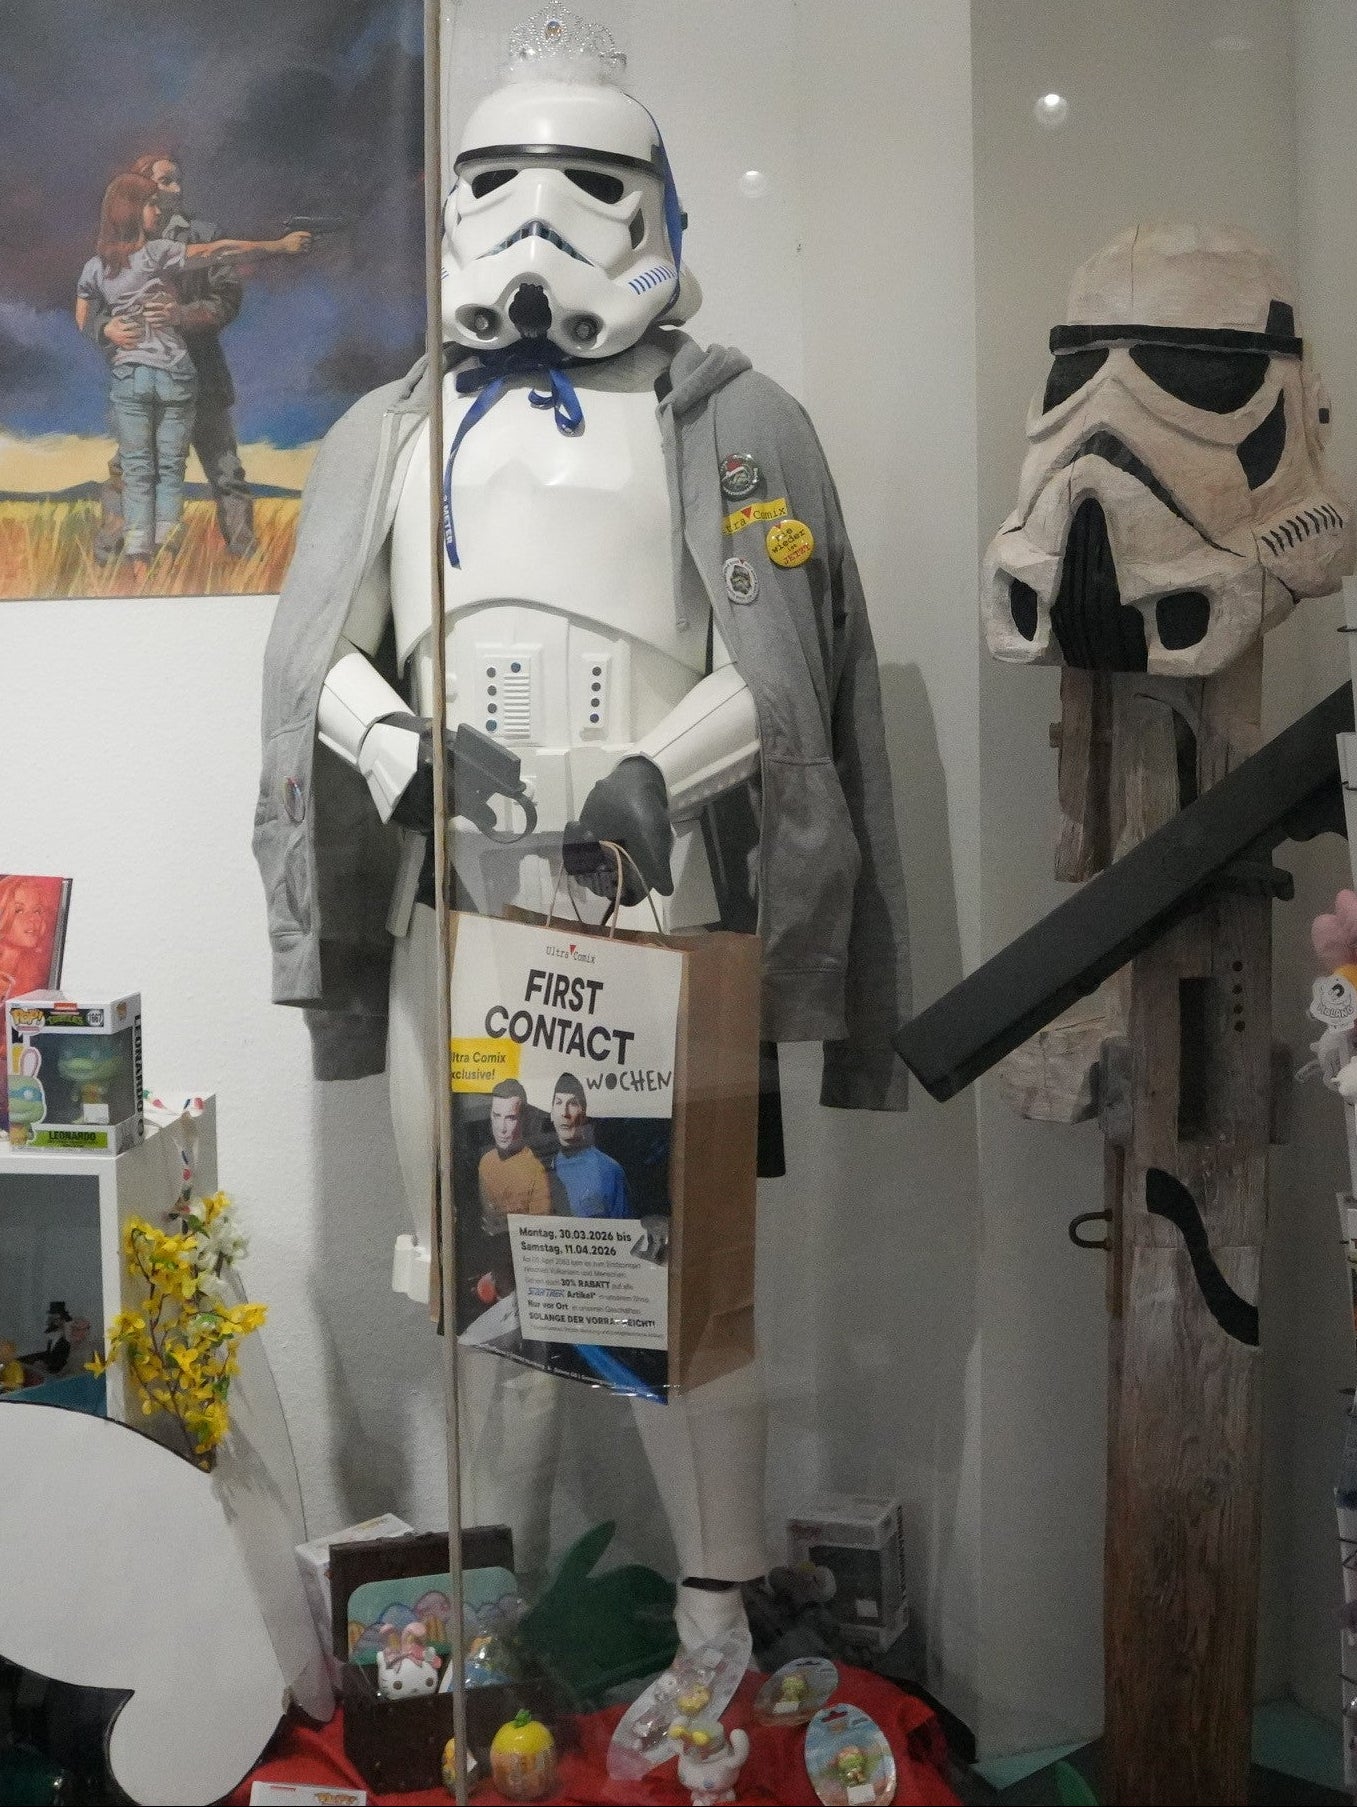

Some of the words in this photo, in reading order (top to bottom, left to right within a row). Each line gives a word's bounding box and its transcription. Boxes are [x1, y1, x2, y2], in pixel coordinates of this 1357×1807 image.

[725, 518, 747, 533] tra
[753, 507, 787, 520] Comix
[546, 946, 569, 959] Ultra
[573, 951, 597, 963] Comix
[524, 968, 604, 1015] FIRST
[484, 1004, 635, 1065] CONTACT
[452, 1052, 470, 1063] ltra
[472, 1051, 506, 1063] Comix
[451, 1068, 495, 1080] xclusive!
[586, 1070, 672, 1092] WOCHEN
[48, 1131, 97, 1141] LEONARDO
[519, 1227, 557, 1239] Montag,
[559, 1229, 614, 1241] 30.03.2026
[616, 1232, 632, 1242] bis
[521, 1241, 563, 1254] Samstag,
[564, 1244, 617, 1256] 11.04.2026
[560, 1278, 577, 1287] 30%
[578, 1280, 610, 1289] RABATT
[556, 1302, 569, 1310] Ort
[529, 1312, 566, 1322] SOLANGE
[567, 1315, 584, 1323] DER
